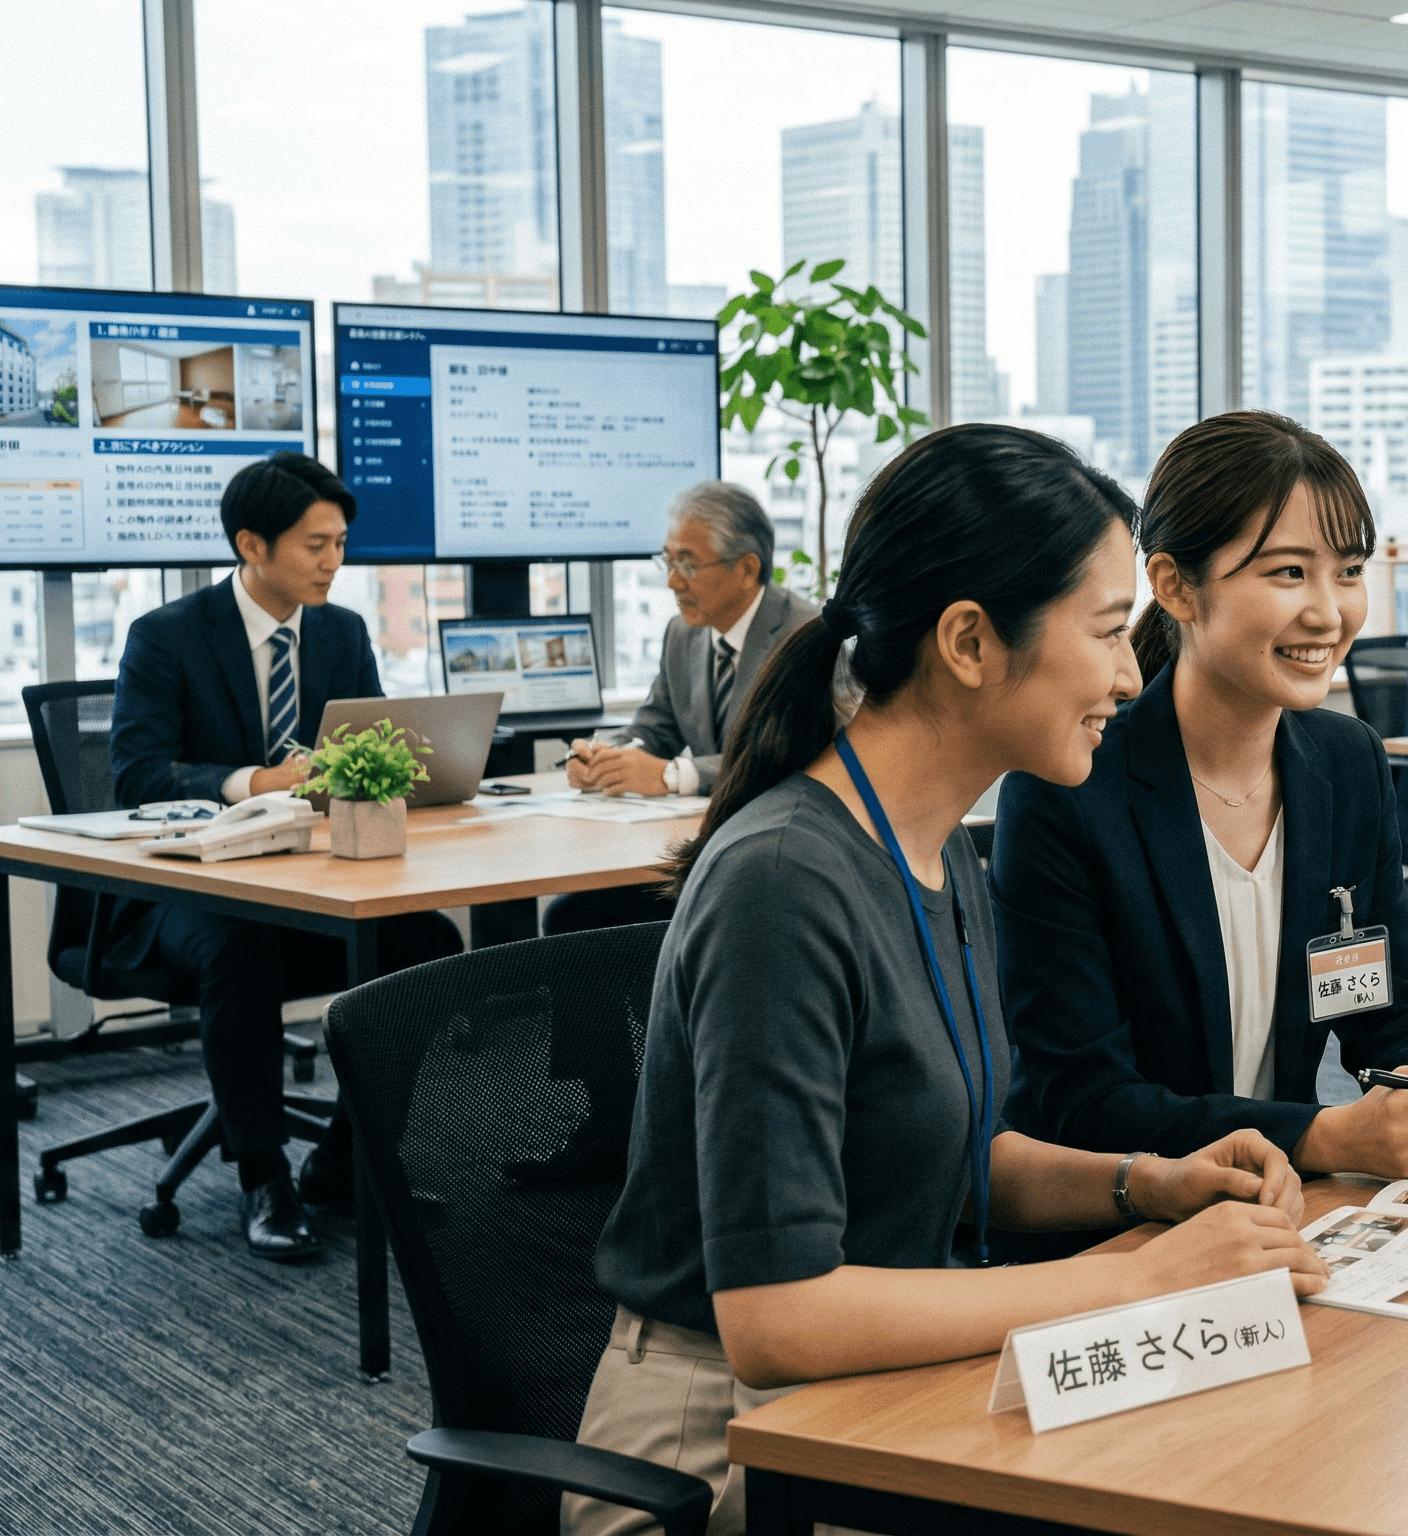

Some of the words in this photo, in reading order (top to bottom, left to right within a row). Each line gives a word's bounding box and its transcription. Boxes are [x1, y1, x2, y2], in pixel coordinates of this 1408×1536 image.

[1318, 978, 1343, 998] 佐藤
[1347, 972, 1380, 991] さくら
[1047, 1339, 1127, 1395] 佐藤
